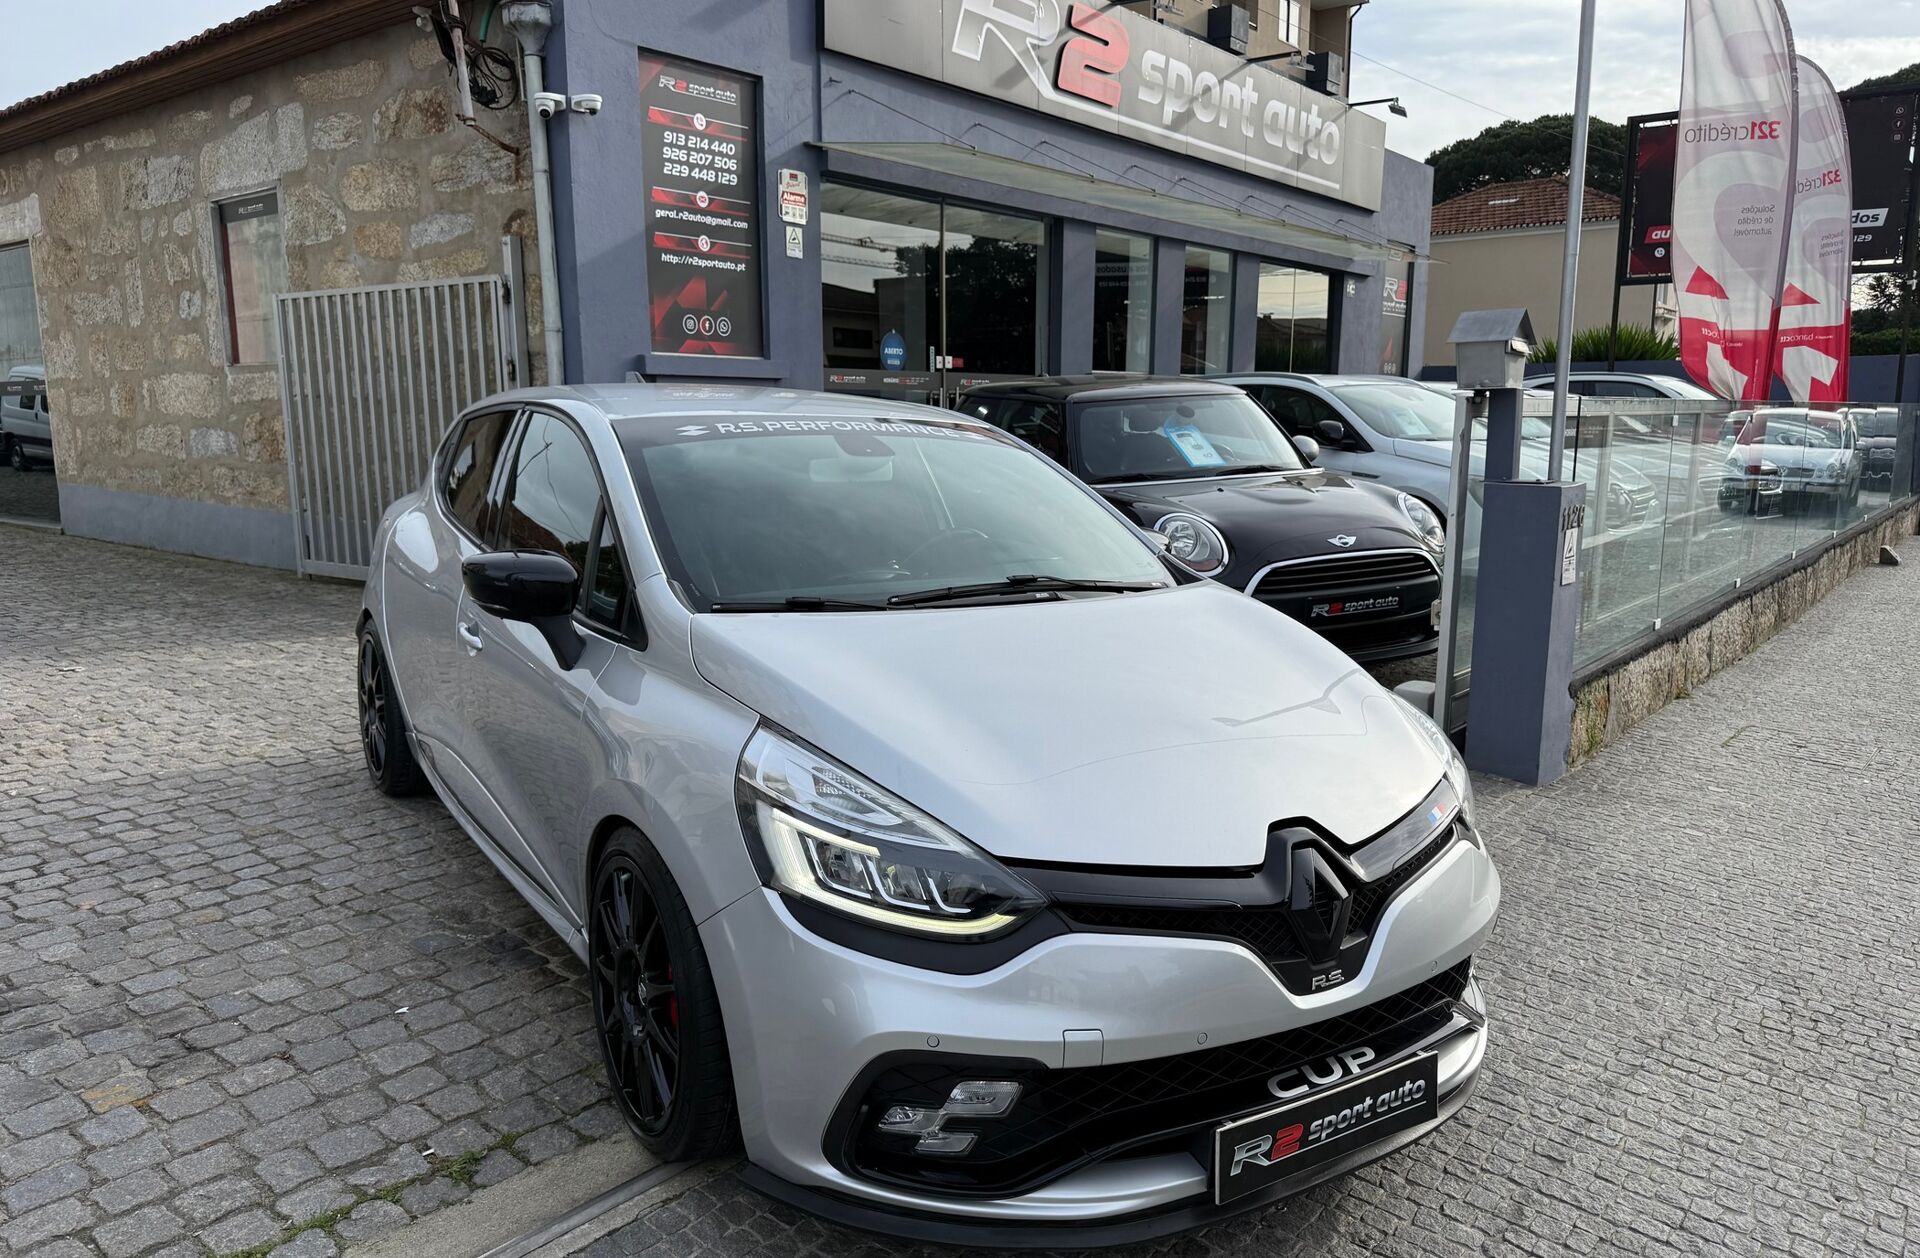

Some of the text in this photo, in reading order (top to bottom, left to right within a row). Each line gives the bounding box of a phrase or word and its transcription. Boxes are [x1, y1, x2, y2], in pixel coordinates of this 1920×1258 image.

[658, 74, 737, 102] R2 sport auto
[1137, 49, 1258, 138] sport
[1262, 99, 1340, 165] auto
[663, 131, 736, 156] 913 214 440
[662, 146, 738, 171] 926 207 506
[663, 162, 738, 186] 229 448 129
[655, 209, 748, 229] geral.r2auto@gmail.com
[661, 253, 746, 272] http://r2sportauto.pt
[1311, 596, 1399, 617] R2 sport auto
[1267, 1046, 1376, 1098] CUP
[1229, 1079, 1427, 1177] R2 sport auto
